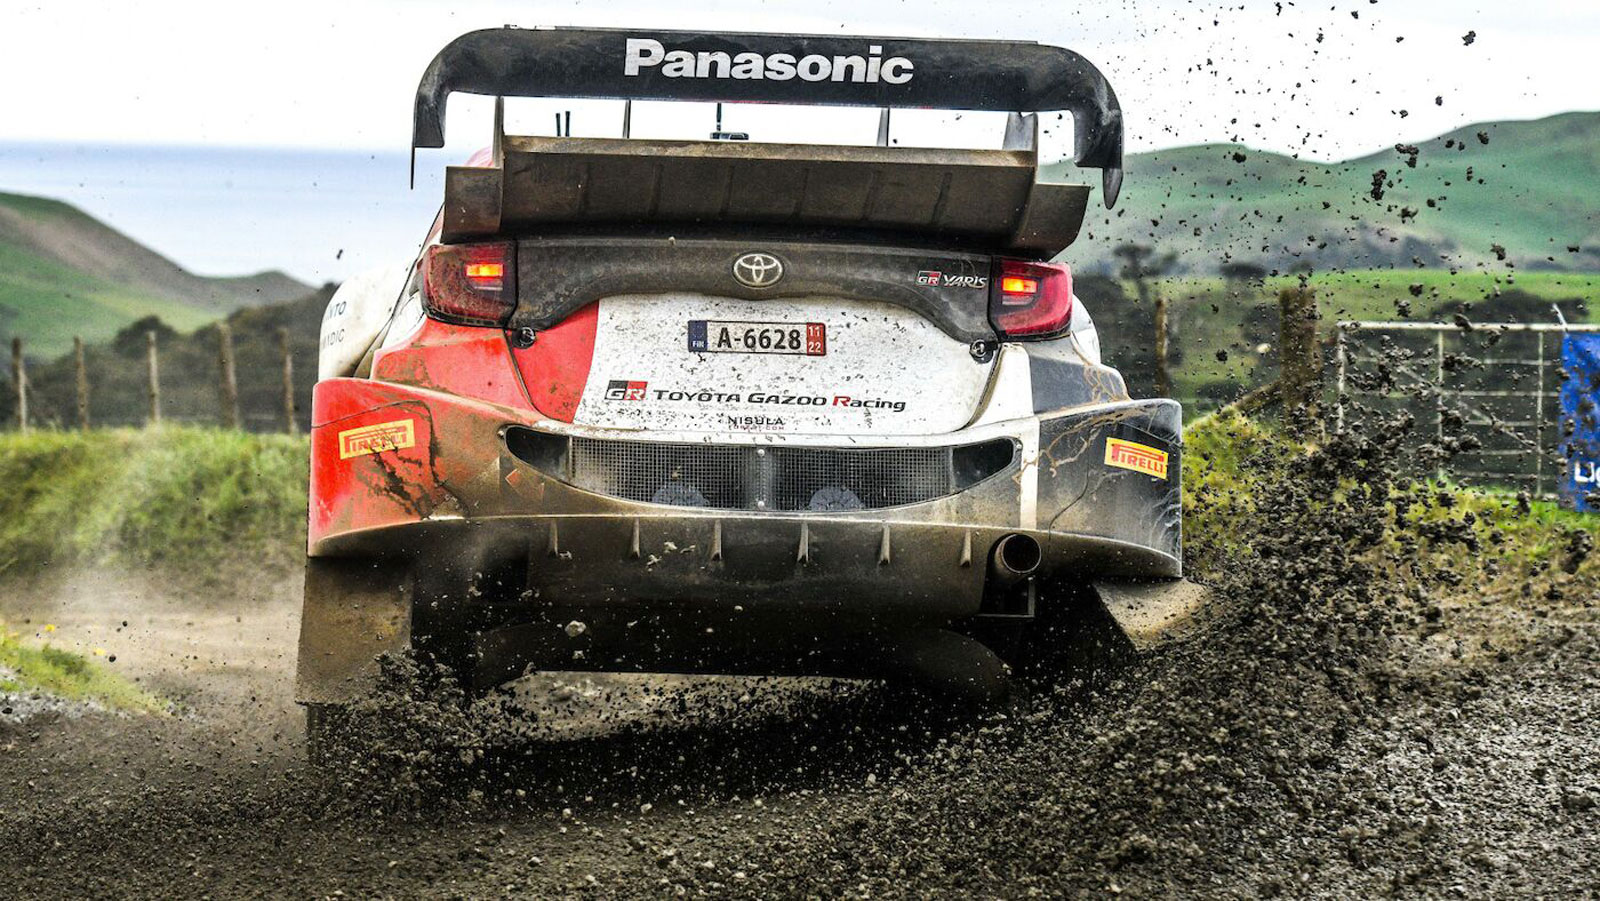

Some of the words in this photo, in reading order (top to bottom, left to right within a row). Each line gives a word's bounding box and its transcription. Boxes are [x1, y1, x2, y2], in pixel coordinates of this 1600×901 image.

[624, 38, 914, 84] Panasonic
[917, 274, 940, 286] GR
[808, 325, 820, 337] 11
[692, 340, 705, 348] FIN
[717, 327, 801, 350] A-6628
[808, 341, 821, 353] 22
[604, 386, 648, 401] GR
[653, 389, 741, 402] TOYOTA
[747, 392, 827, 406] GAZOO
[832, 395, 906, 412] Racing
[728, 416, 785, 426] NISULA
[1111, 443, 1165, 473] PIRELLI
